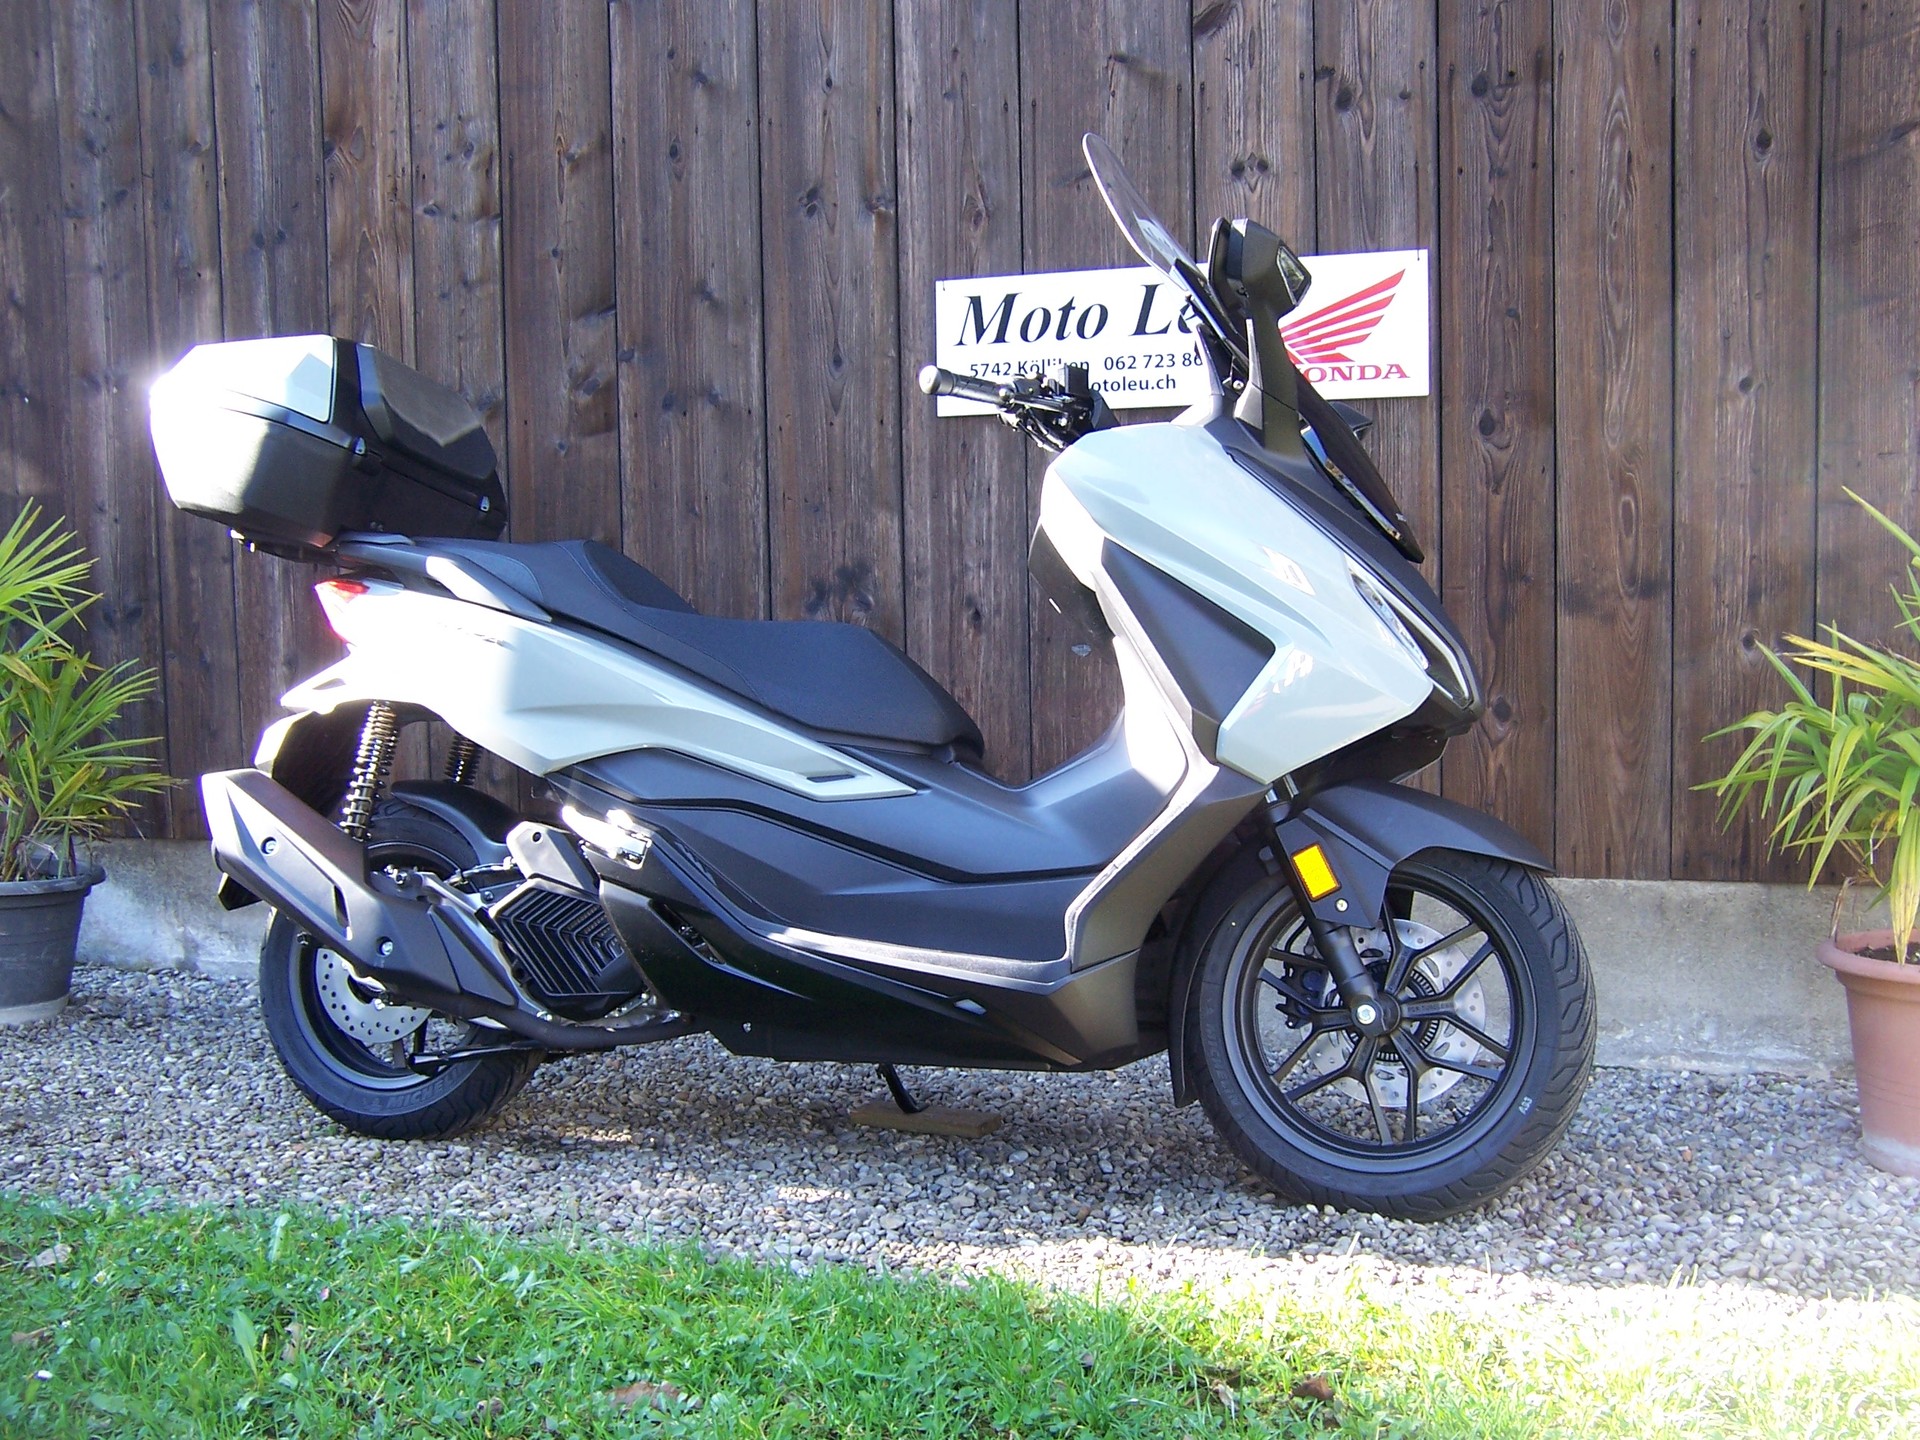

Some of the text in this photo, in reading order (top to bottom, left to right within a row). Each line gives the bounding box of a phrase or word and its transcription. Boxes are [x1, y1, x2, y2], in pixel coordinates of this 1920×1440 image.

[953, 282, 1199, 347] Moto Le
[969, 361, 1012, 378] 5742
[1103, 356, 1137, 371] 062
[1143, 353, 1176, 369] 723
[1299, 363, 1411, 384] ONDA
[1091, 373, 1177, 393] otoleu.ch
